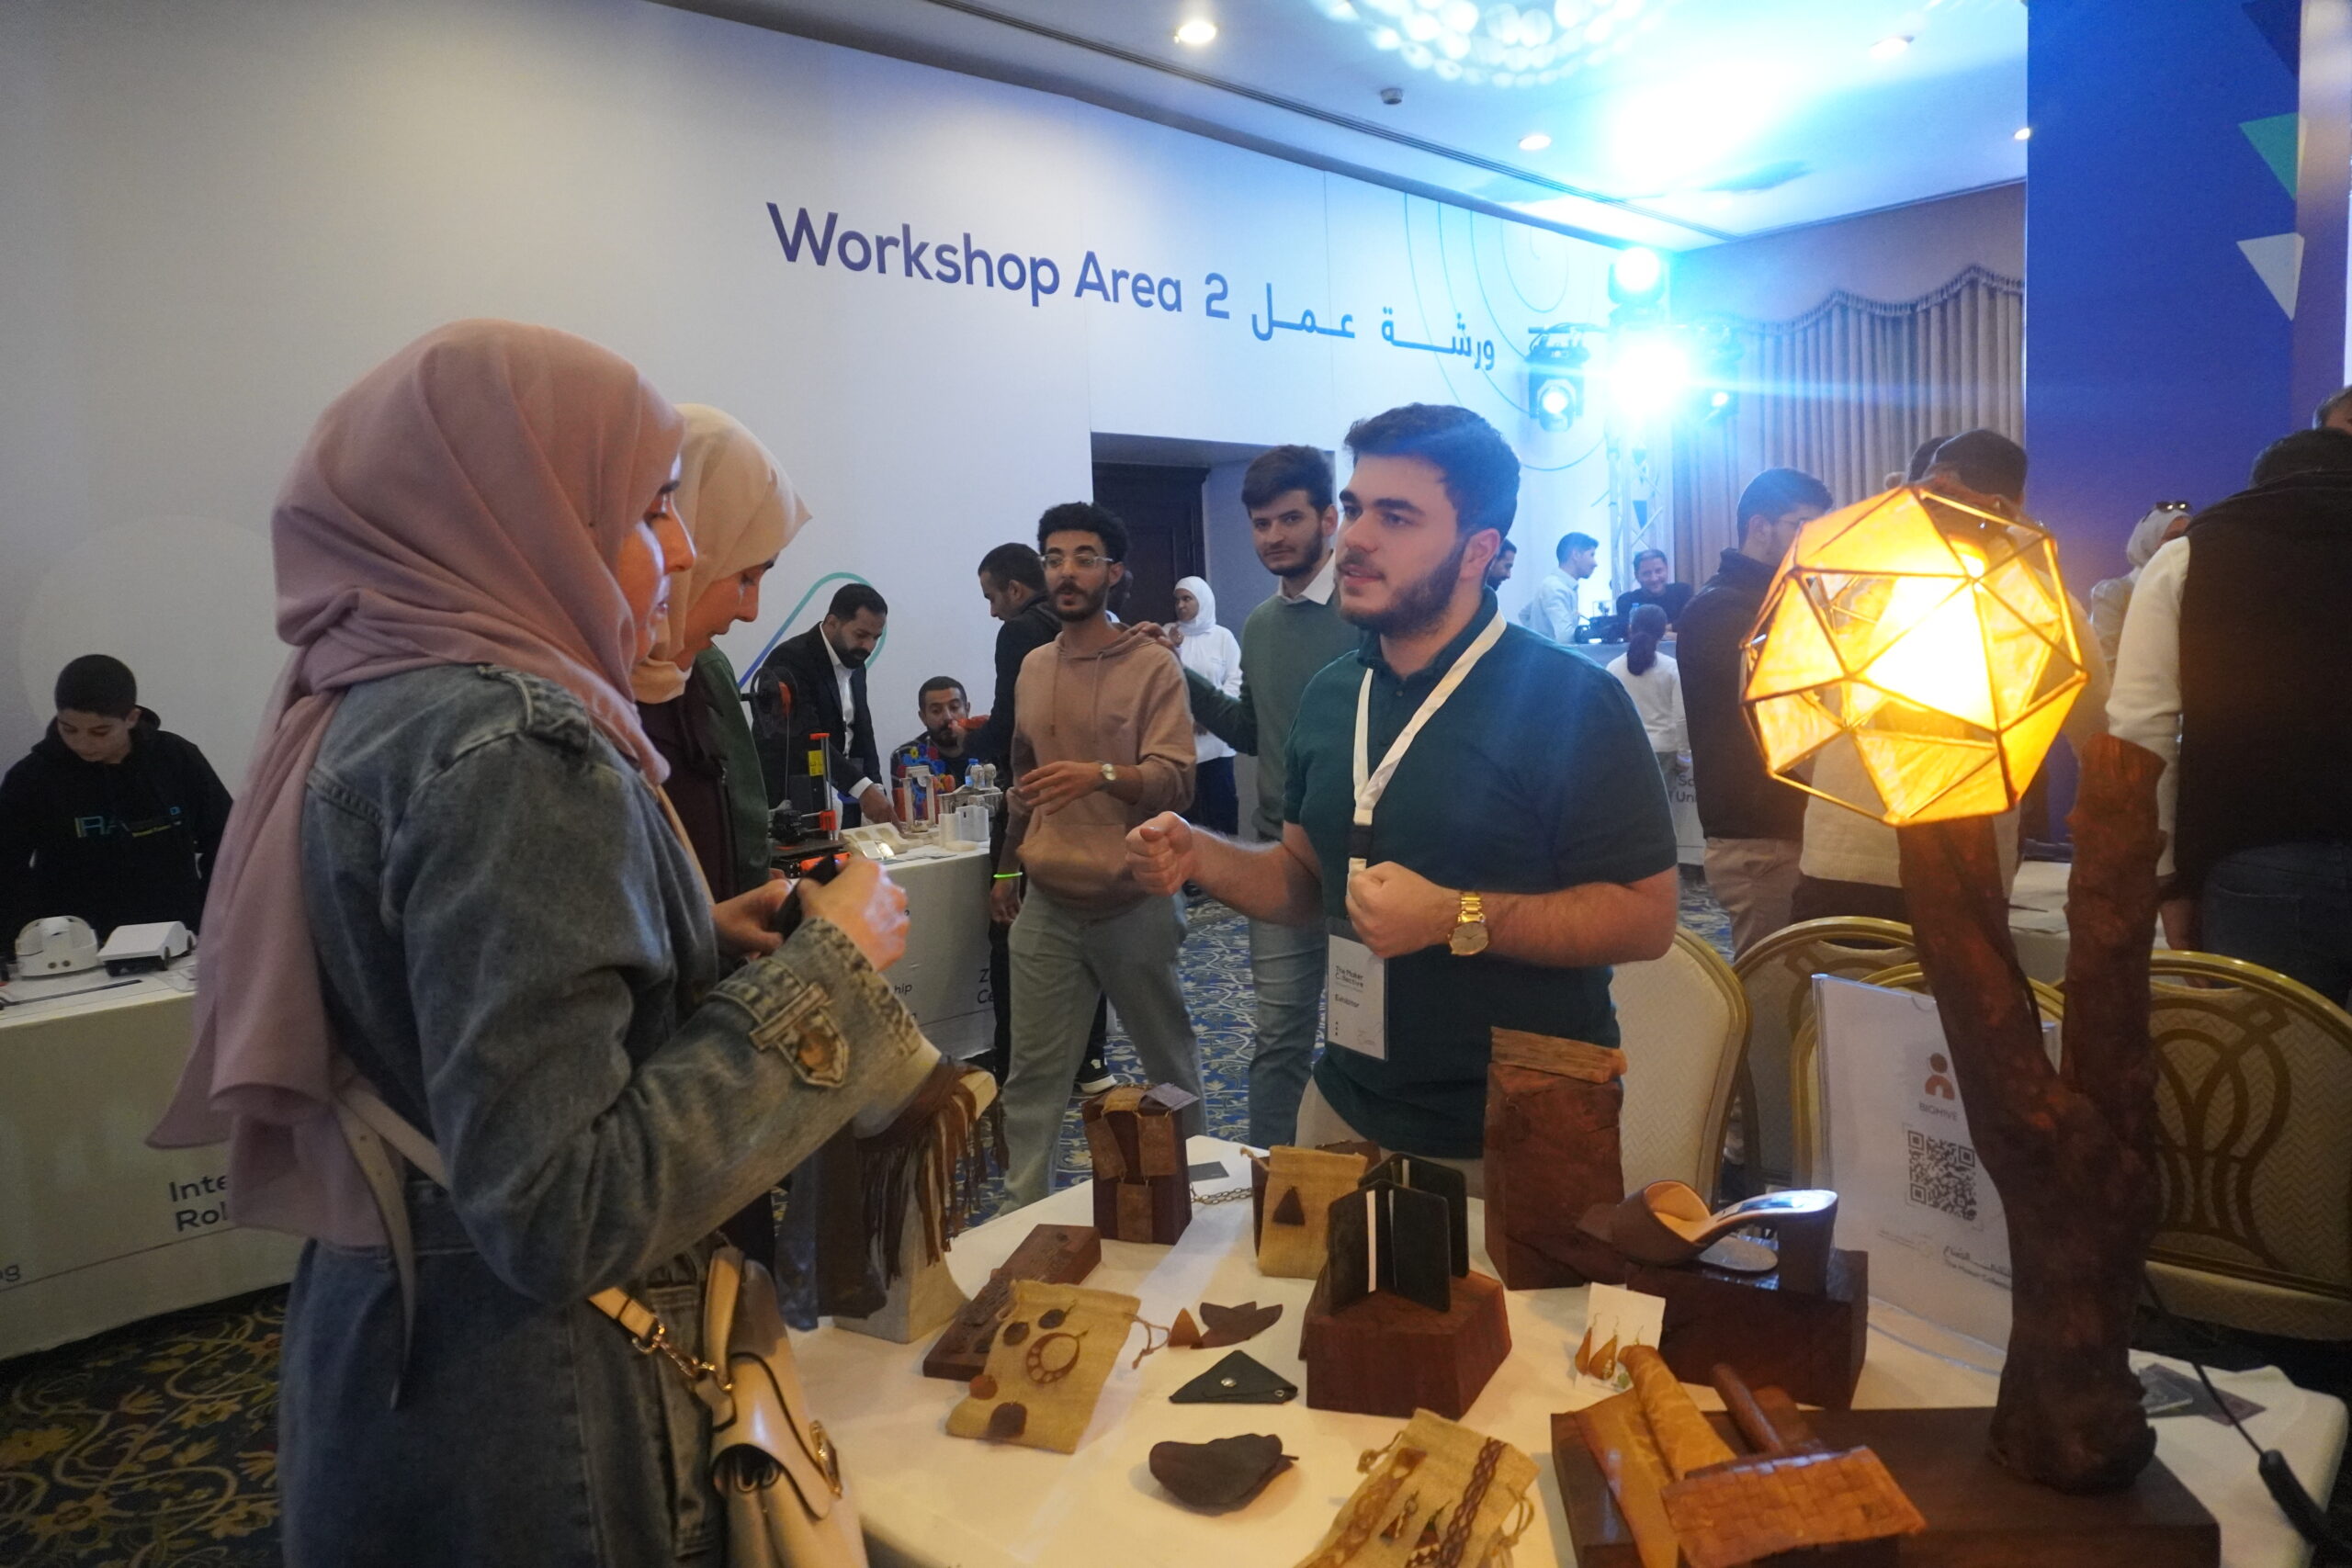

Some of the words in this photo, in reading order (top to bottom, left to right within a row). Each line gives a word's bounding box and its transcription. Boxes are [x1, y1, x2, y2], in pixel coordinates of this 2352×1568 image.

[766, 202, 1060, 306] Workshop
[1075, 251, 1182, 313] Area
[1204, 273, 1231, 320] 2
[1251, 283, 1355, 341] عمل
